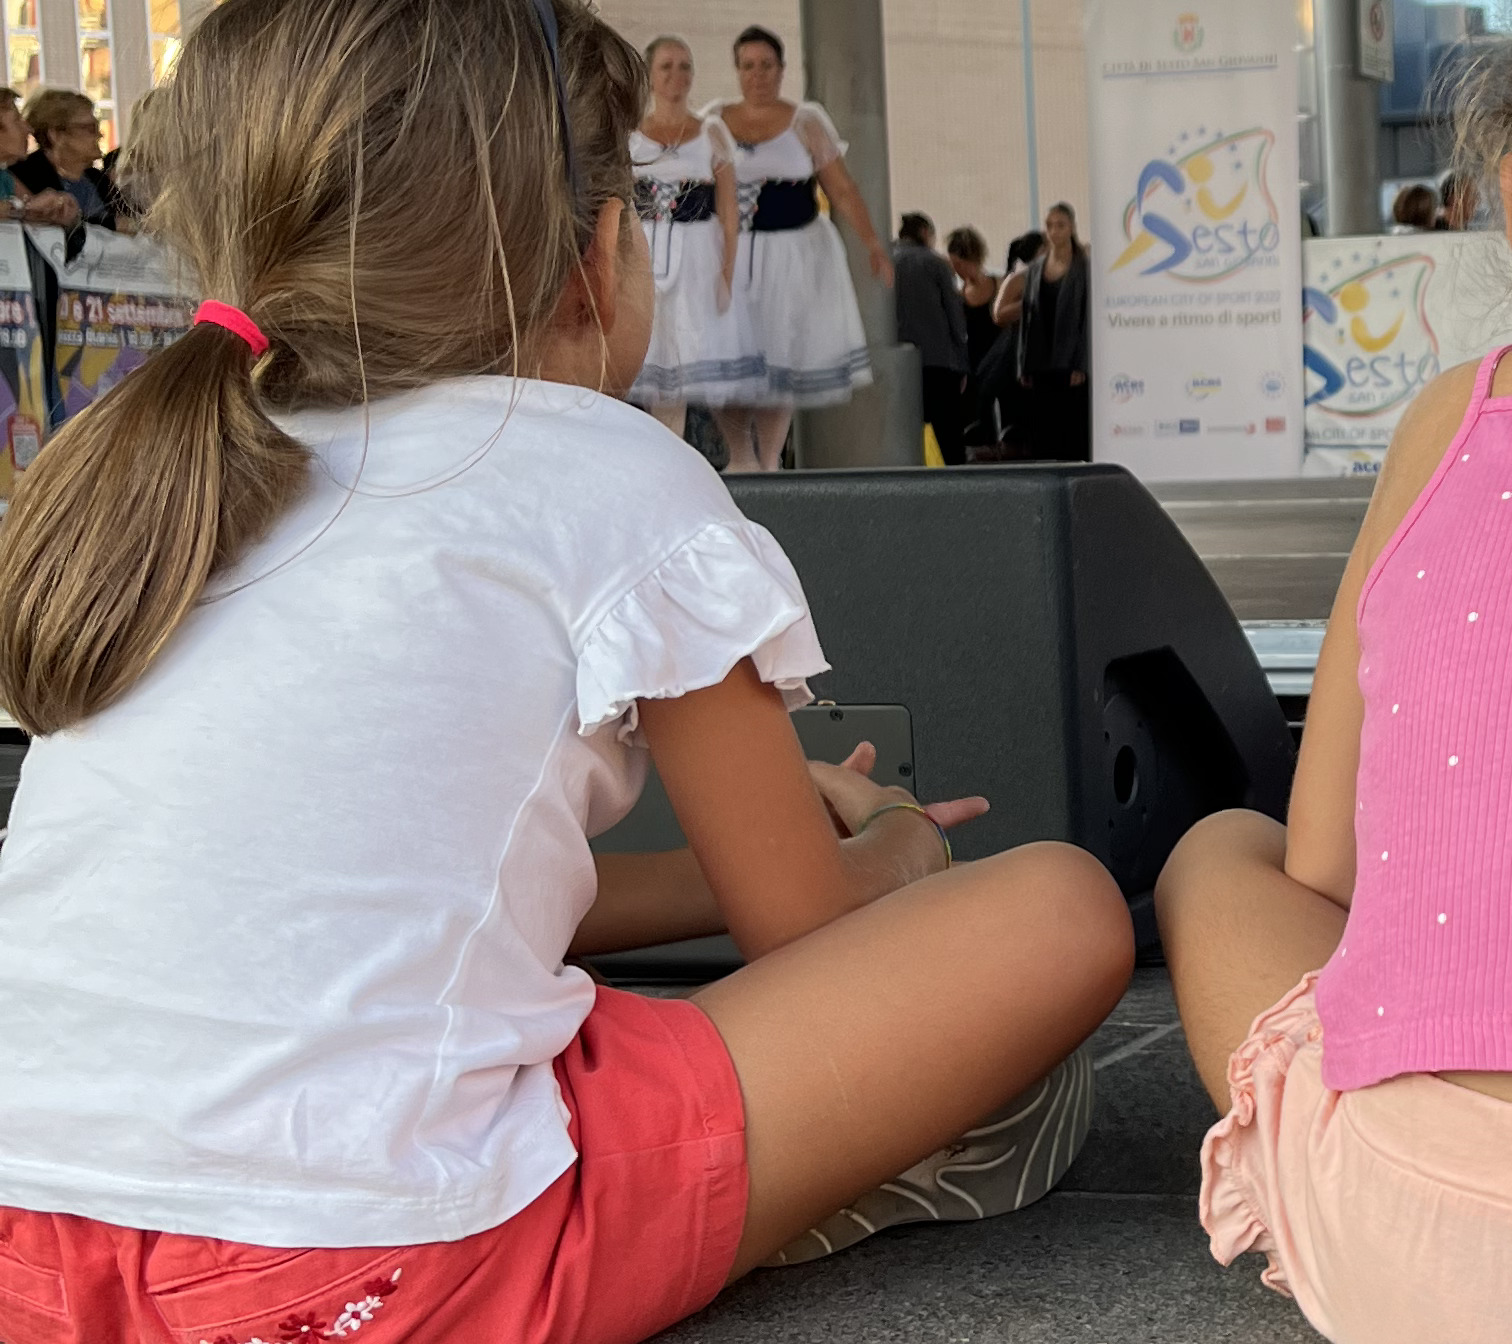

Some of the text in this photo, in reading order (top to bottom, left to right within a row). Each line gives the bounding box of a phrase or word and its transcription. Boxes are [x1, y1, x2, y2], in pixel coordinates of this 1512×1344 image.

[1107, 312, 1157, 328] Vivere
[1172, 312, 1215, 327] ritmo
[1218, 309, 1233, 324] di
